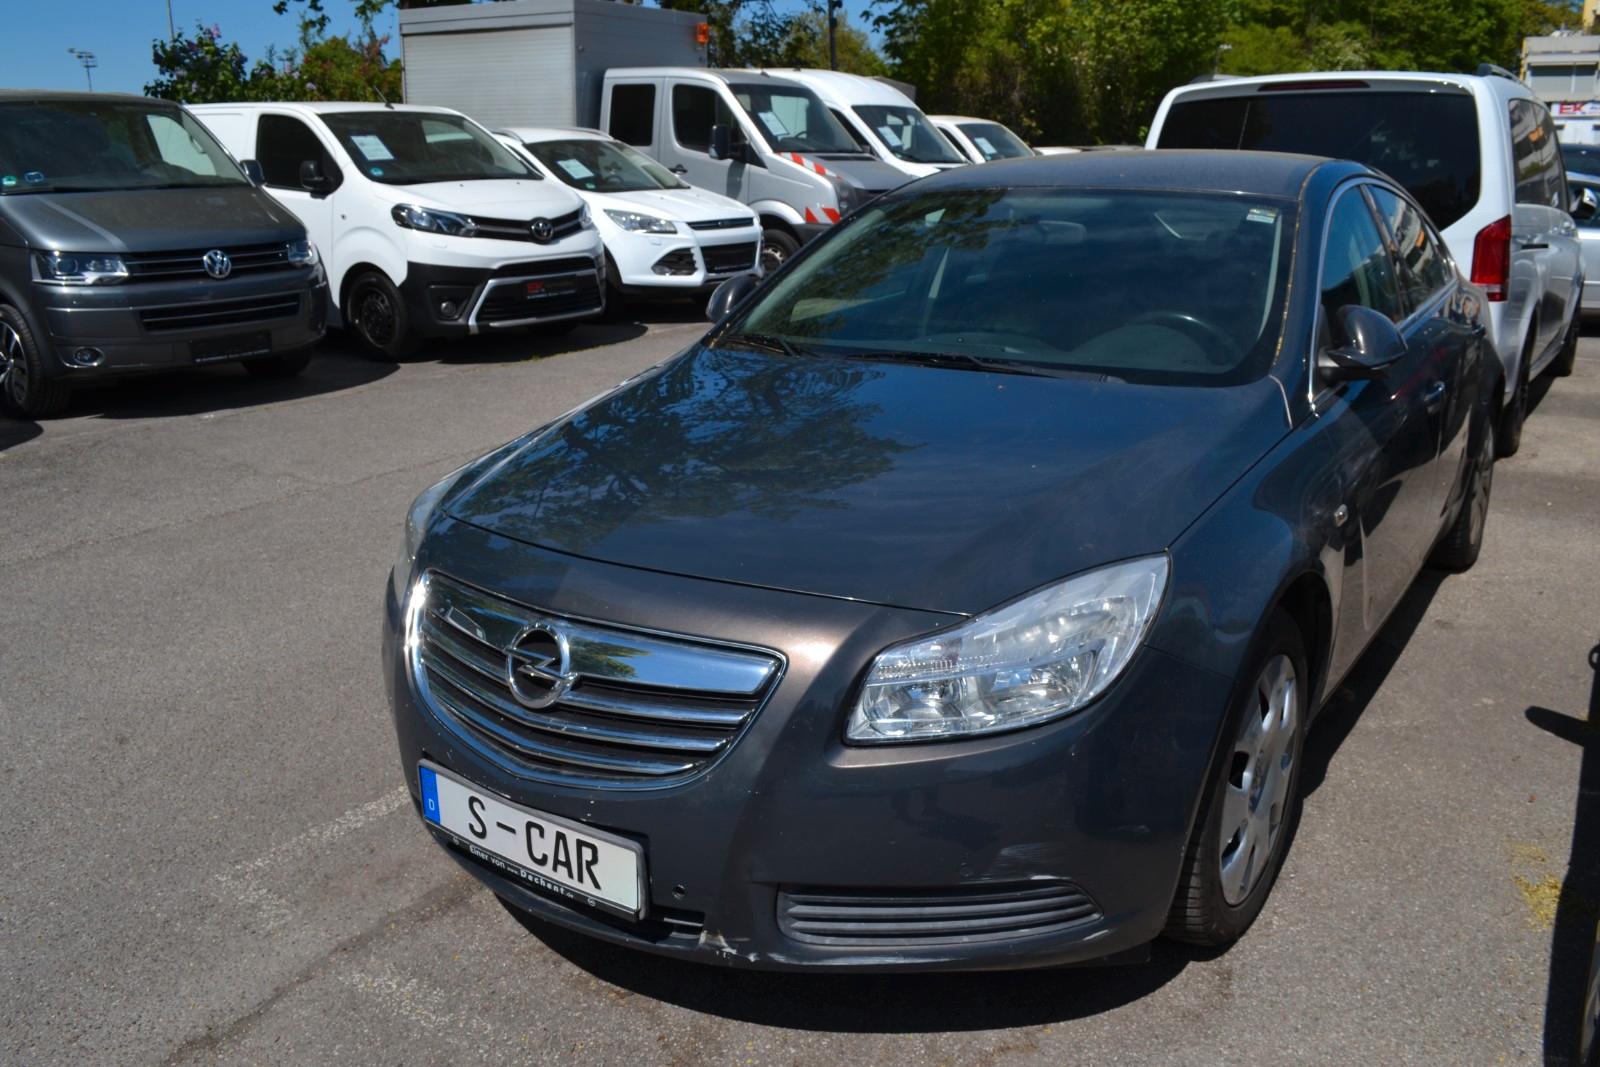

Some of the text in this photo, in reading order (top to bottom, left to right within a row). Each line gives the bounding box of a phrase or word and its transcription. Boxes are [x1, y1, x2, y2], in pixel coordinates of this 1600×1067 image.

[428, 798, 435, 811] D
[470, 845, 489, 861] Einer
[491, 857, 506, 869] von
